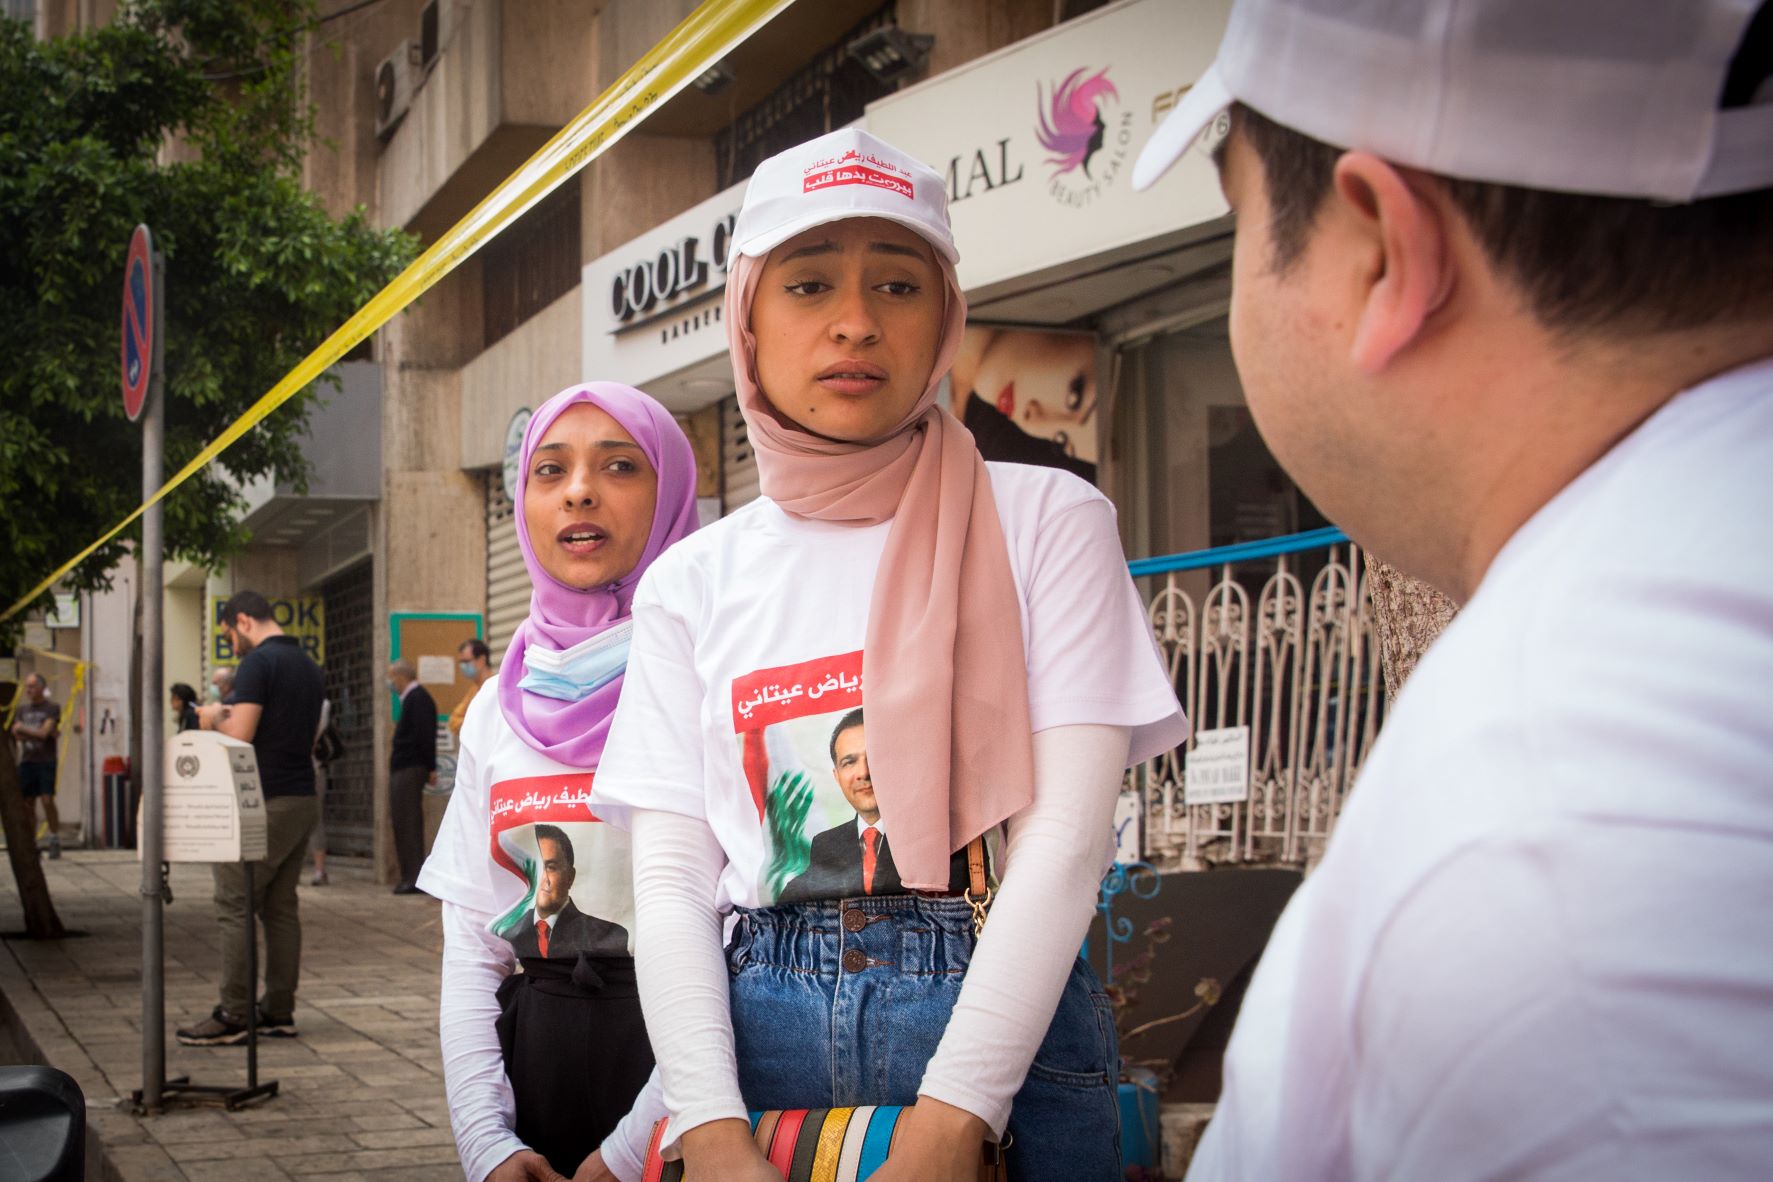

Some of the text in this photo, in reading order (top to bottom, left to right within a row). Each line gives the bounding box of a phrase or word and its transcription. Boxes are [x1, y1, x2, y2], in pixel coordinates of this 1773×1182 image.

[803, 157, 836, 176] عيتاني
[866, 153, 897, 172] اللطيف
[1048, 111, 1134, 209] BEAUTY SALON
[805, 171, 834, 190] قلب
[836, 169, 867, 182] بدها
[610, 236, 709, 322] COOL
[737, 671, 864, 720] ياض عيتاني
[515, 791, 551, 813] رياض
